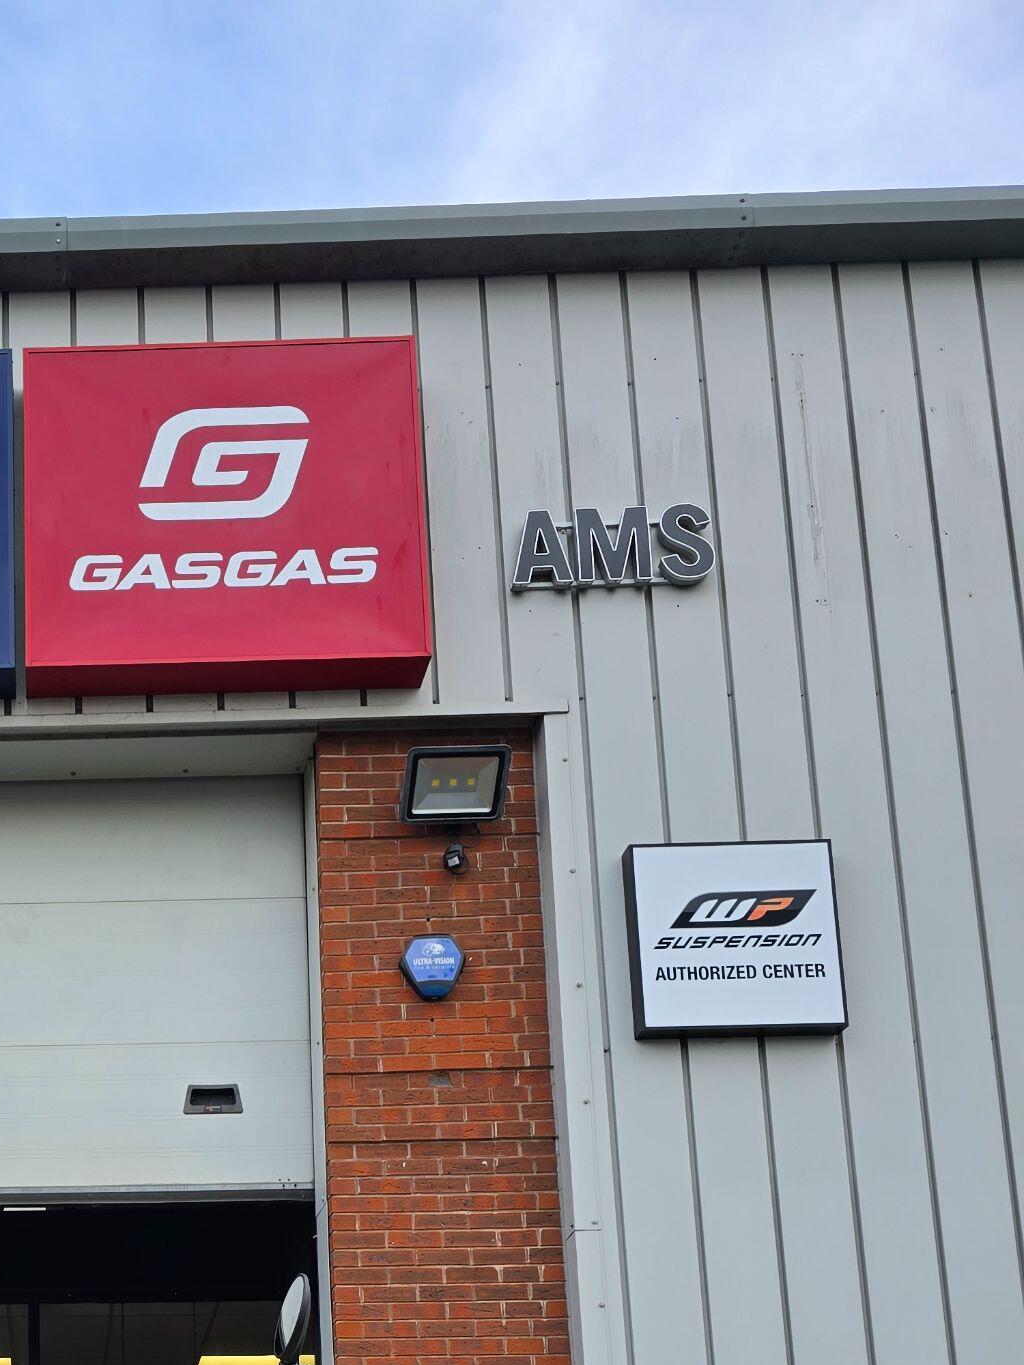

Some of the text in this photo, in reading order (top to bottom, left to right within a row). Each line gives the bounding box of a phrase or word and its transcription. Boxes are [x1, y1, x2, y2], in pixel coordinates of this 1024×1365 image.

[512, 502, 715, 592] AMS
[69, 546, 379, 591] GASGAS
[688, 896, 795, 923] WP
[653, 933, 823, 950] SUSPENSION
[412, 956, 455, 966] ULTRA-VISION
[655, 963, 826, 982] AUTHORIZED CENTER
